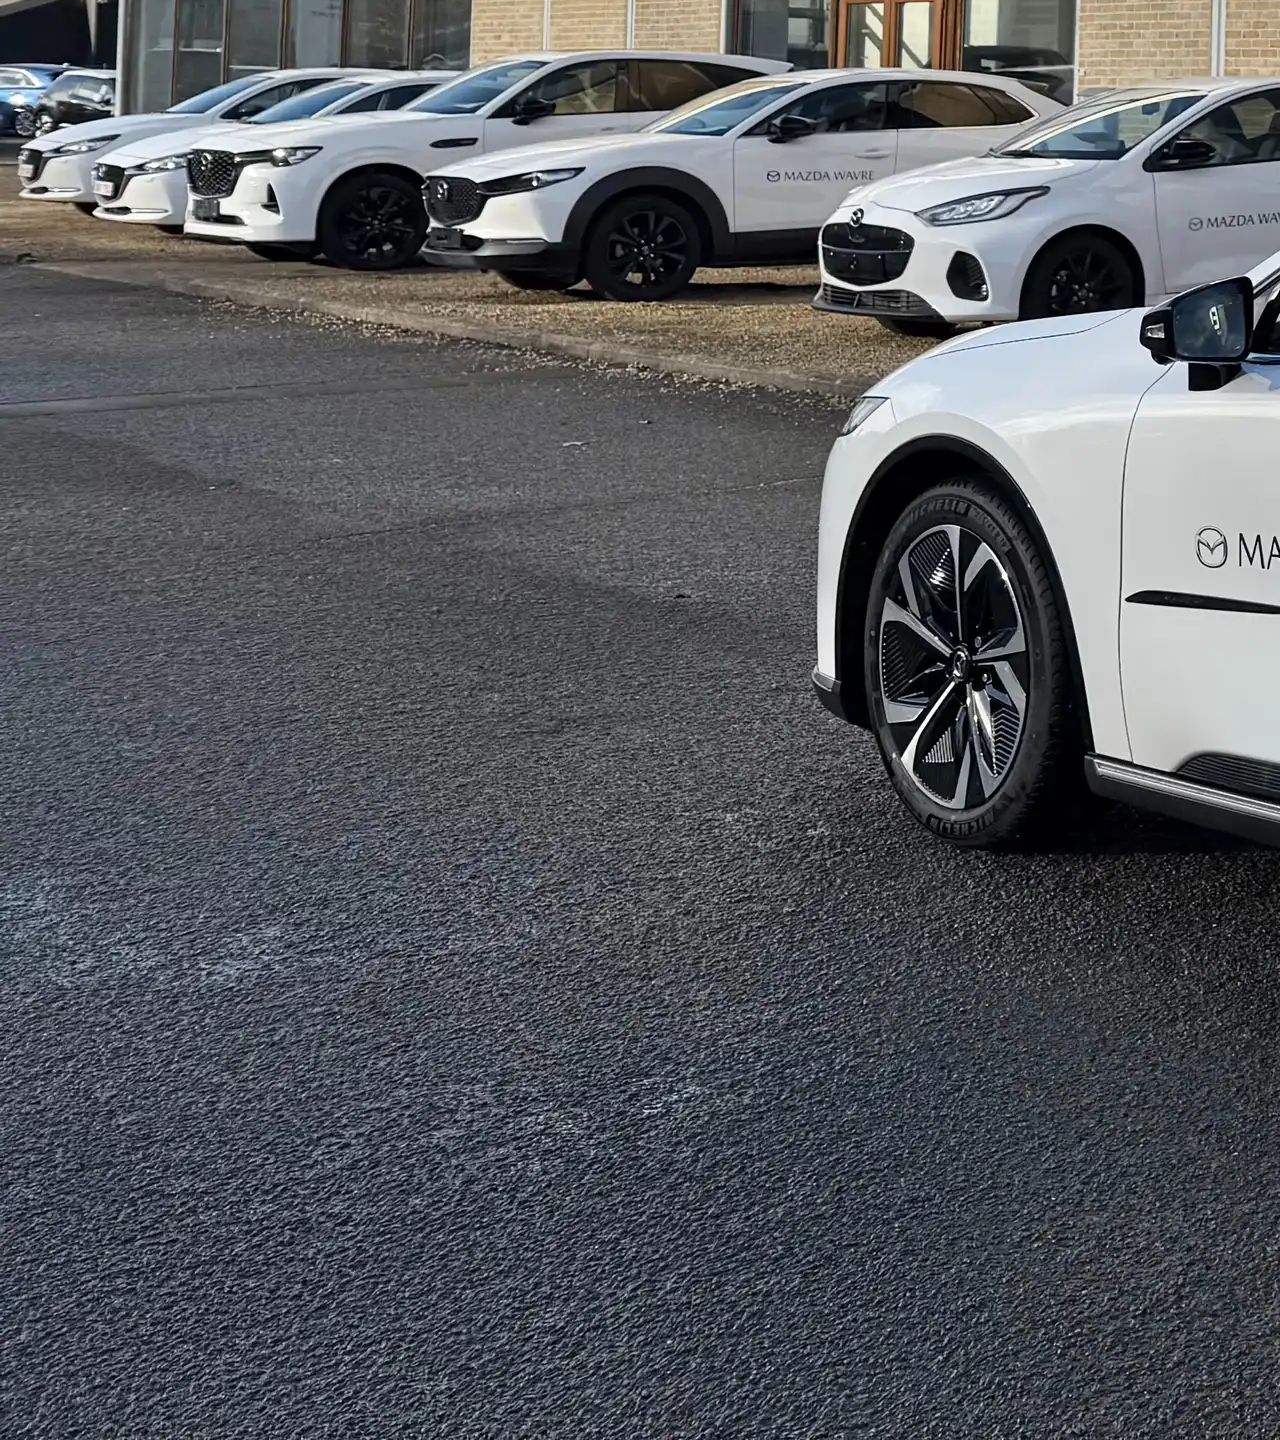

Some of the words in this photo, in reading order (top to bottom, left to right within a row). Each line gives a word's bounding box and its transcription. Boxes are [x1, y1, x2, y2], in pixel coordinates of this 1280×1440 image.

[784, 171, 831, 181] MAZDA
[833, 170, 874, 180] WAVRE
[1206, 214, 1255, 229] MAZDA
